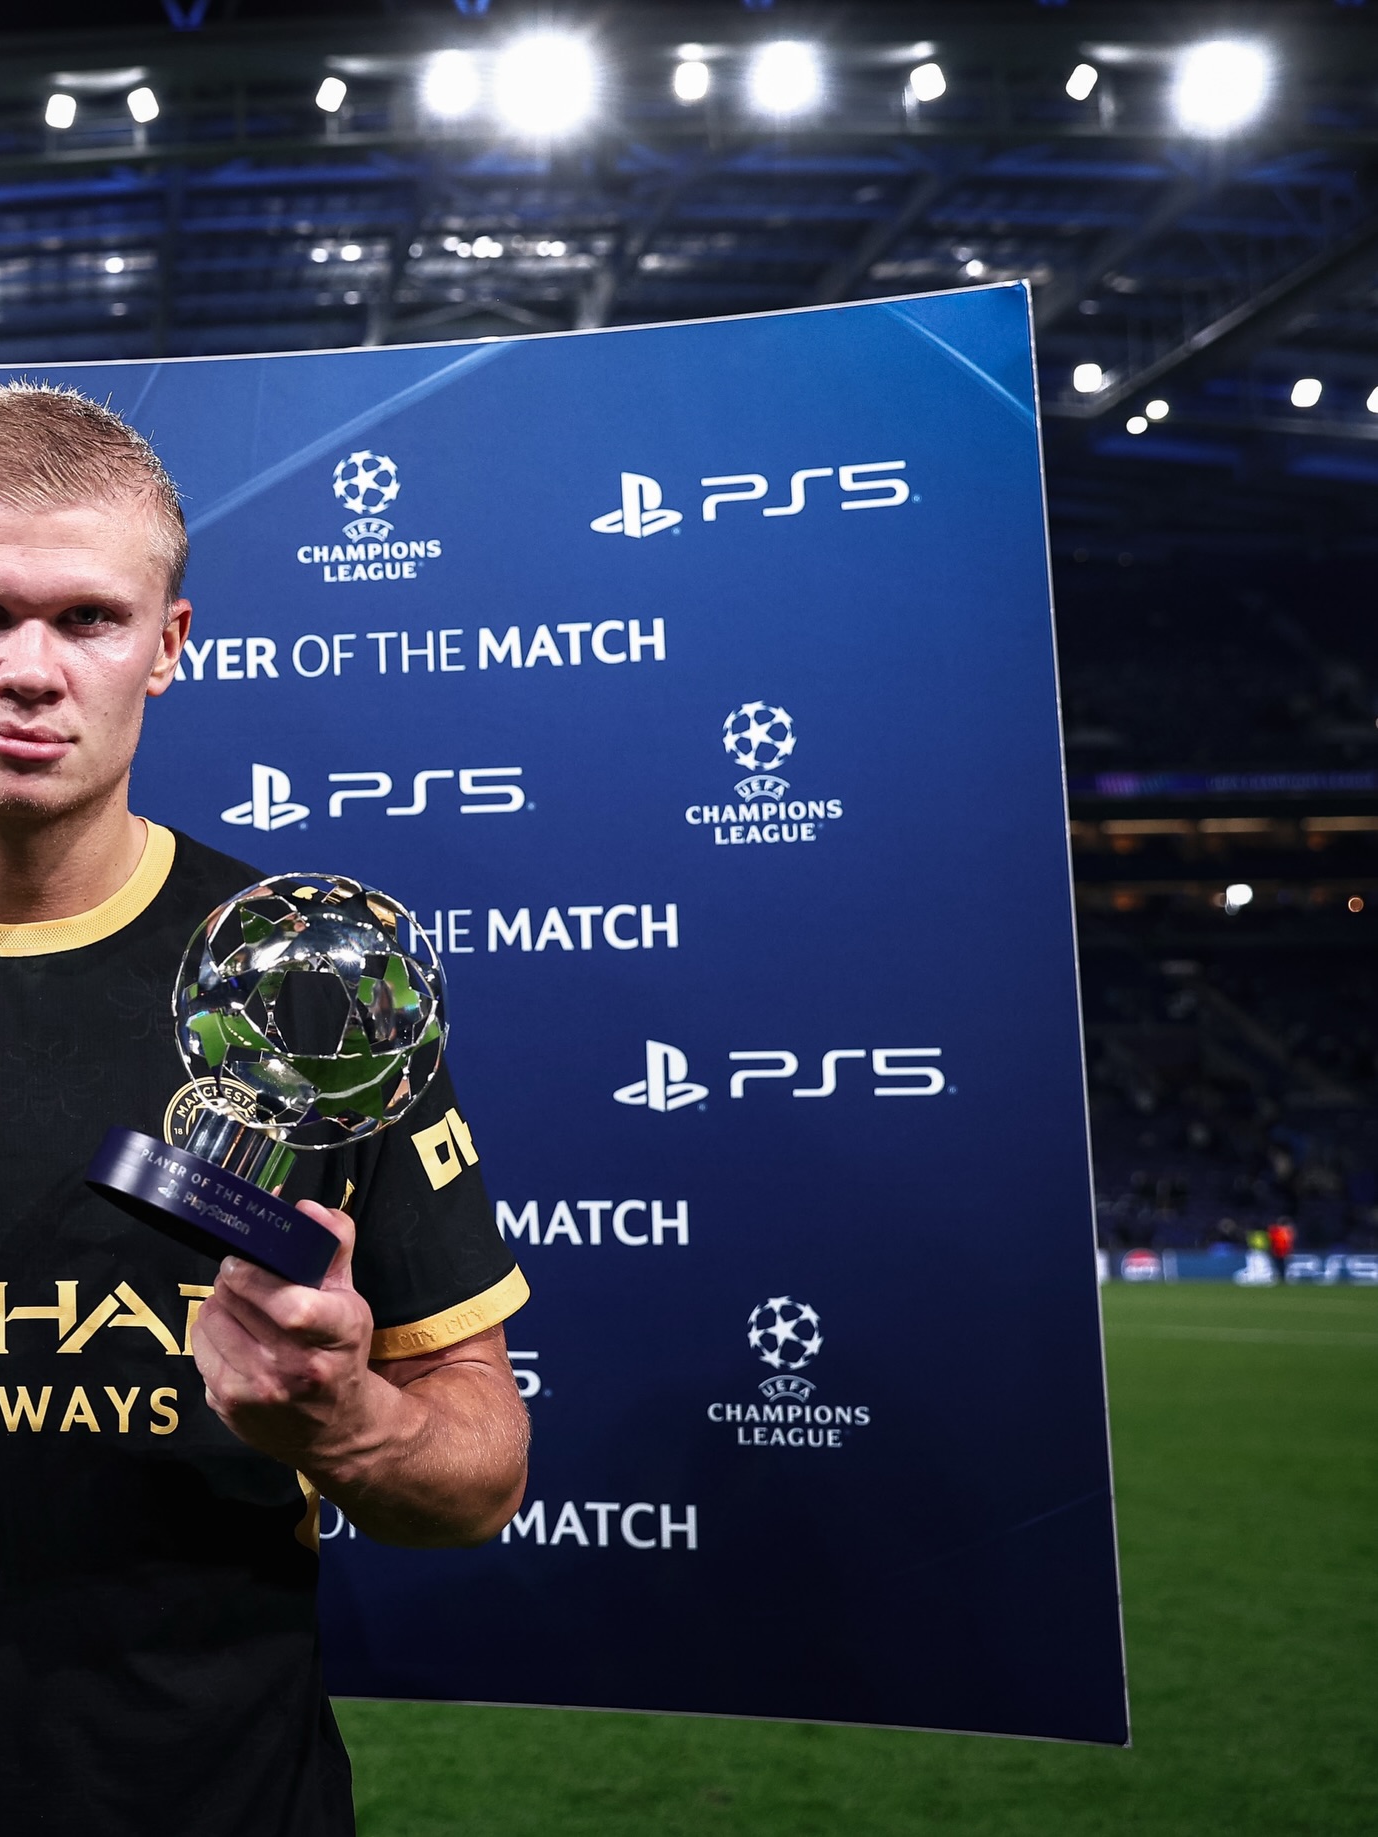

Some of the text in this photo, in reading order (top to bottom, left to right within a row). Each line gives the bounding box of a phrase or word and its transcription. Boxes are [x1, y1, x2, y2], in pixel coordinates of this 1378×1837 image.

[700, 460, 910, 522] PS5
[344, 522, 390, 539] UEFA
[296, 539, 442, 564] CHAMPIONS
[323, 561, 417, 583] LEAGUE
[175, 617, 666, 681] YER OF THE MATCH
[328, 766, 525, 818] PS5
[736, 780, 786, 798] UEFA
[685, 799, 843, 825] CHAMPIONS
[714, 822, 817, 846] LEAGUE
[396, 903, 679, 955] HE MATCH
[728, 1047, 945, 1099] PS5
[140, 1148, 292, 1234] PLAYER OF THE MATCH
[183, 1190, 251, 1236] PlayStation
[495, 1199, 689, 1246] MATCH
[398, 1324, 438, 1350] CITY
[761, 1379, 811, 1399] UEFA
[707, 1402, 871, 1425] CHAMPIONS
[737, 1426, 842, 1448] LEAGUE
[501, 1500, 697, 1549] MATCH
